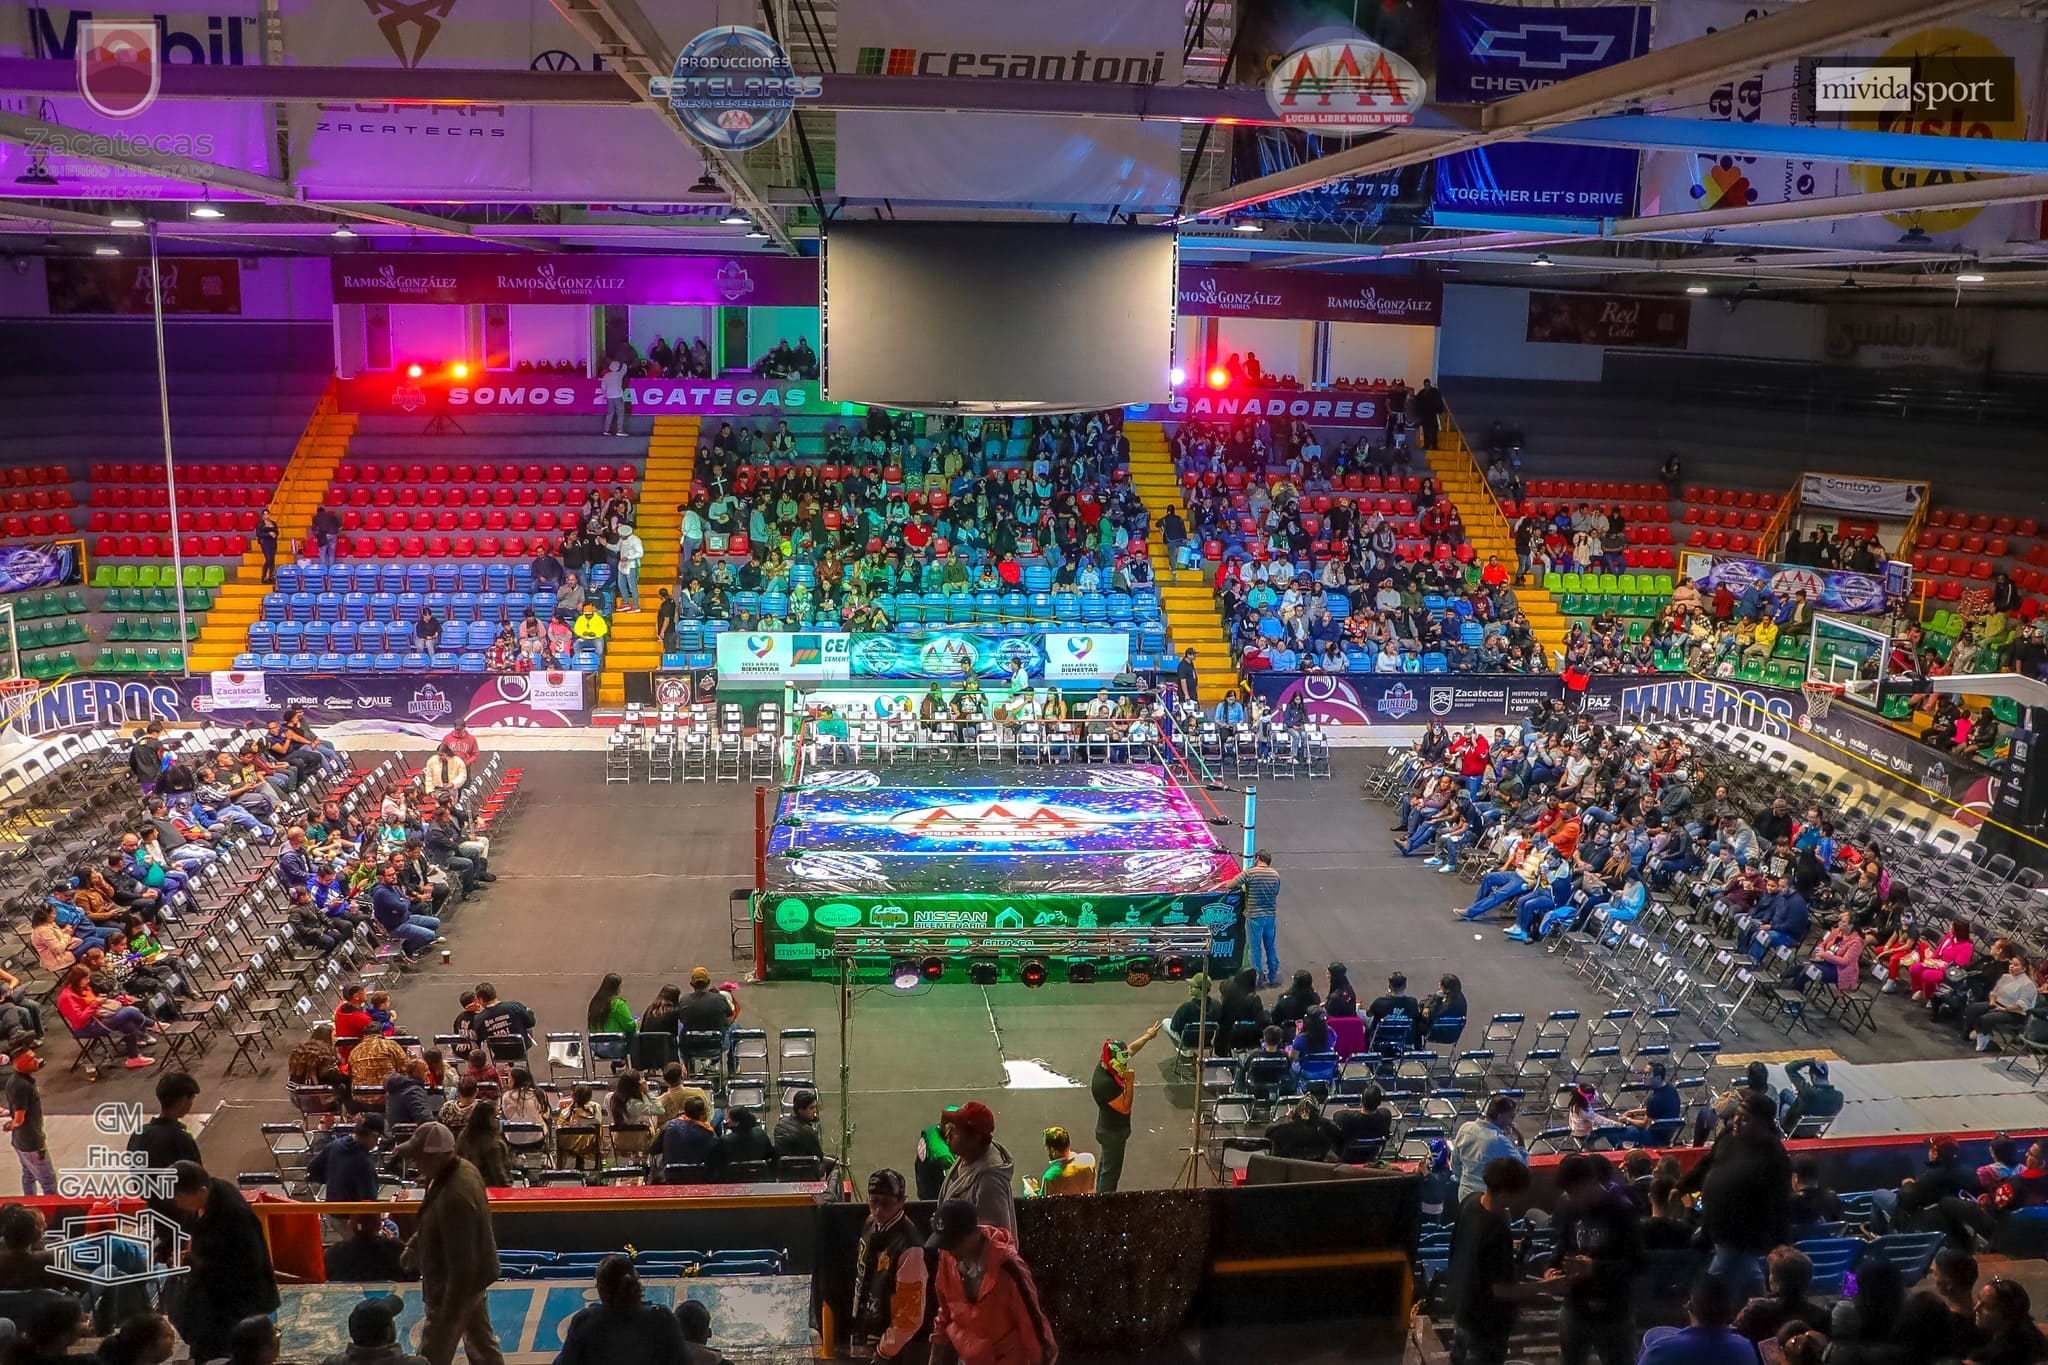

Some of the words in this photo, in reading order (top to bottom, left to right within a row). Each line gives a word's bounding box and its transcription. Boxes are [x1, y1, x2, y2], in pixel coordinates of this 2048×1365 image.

[28, 8, 243, 65] Mbil
[918, 50, 1165, 83] cesantoni
[1471, 76, 1562, 92] CHEVR
[316, 122, 505, 137] ZACATECAS
[1321, 182, 1350, 195] 924
[1356, 183, 1378, 195] 77
[1381, 184, 1399, 196] 78
[1450, 187, 1530, 203] TOGETHER
[1579, 192, 1624, 205] DRIVE
[134, 264, 178, 289] Rd
[1179, 291, 1282, 306] MOS&GONZÁLEZ
[448, 387, 576, 405] SOMOS
[1168, 397, 1376, 420] GANADORES
[215, 687, 261, 696] Zacatecas
[534, 689, 579, 697] Zacatecas
[1455, 689, 1504, 698] Zacatecas
[287, 696, 318, 705] molten
[408, 701, 452, 714] MINEROS
[1588, 698, 1612, 707] PAZ
[1621, 680, 1792, 742] MINEROS
[914, 911, 988, 922] NISSAN
